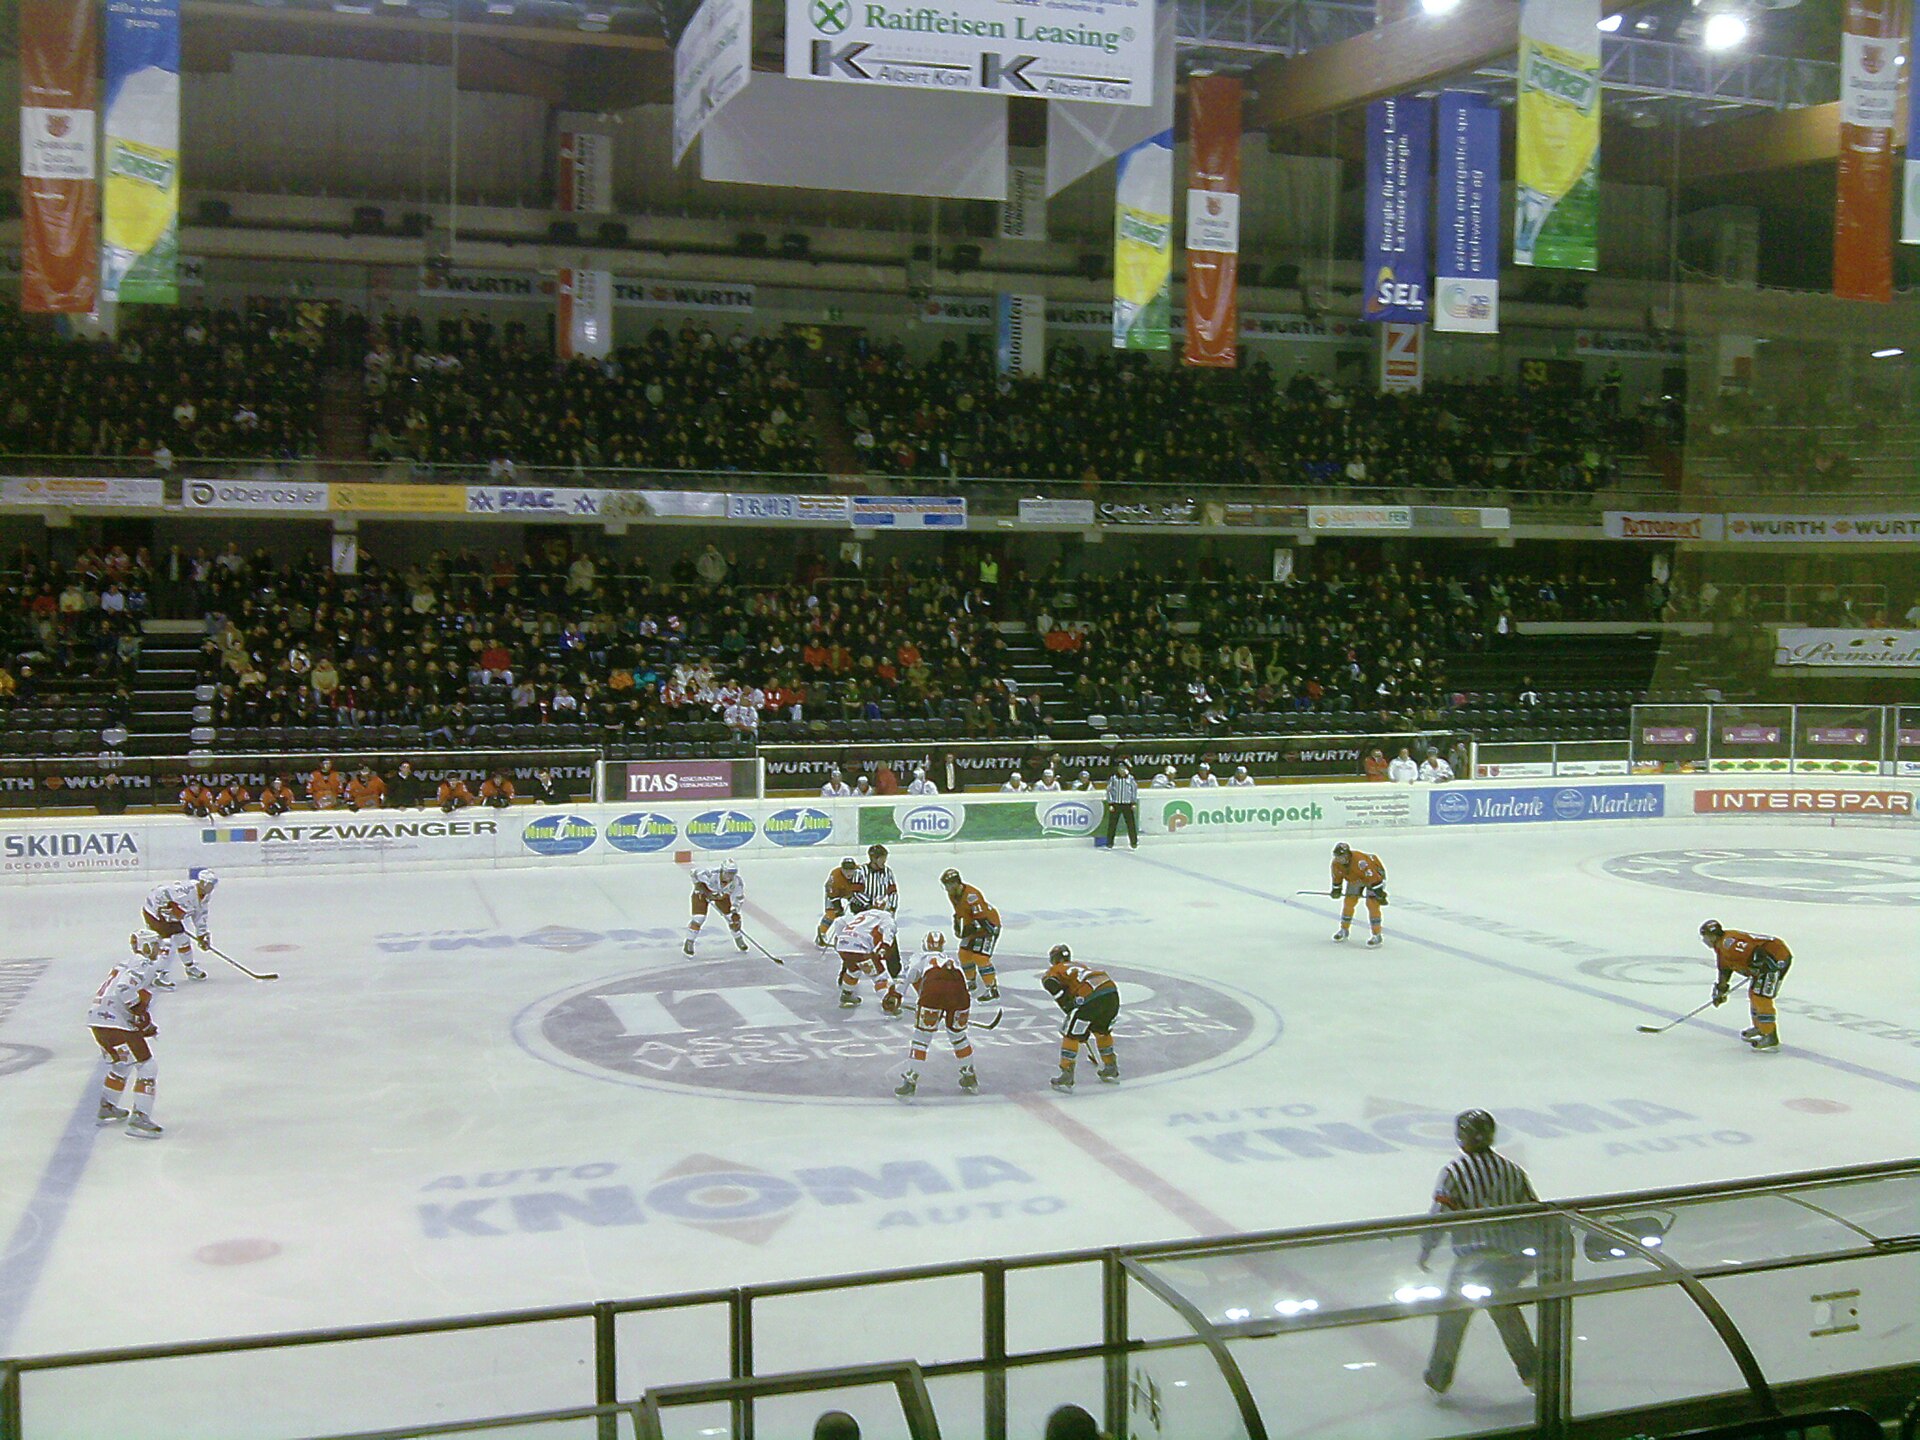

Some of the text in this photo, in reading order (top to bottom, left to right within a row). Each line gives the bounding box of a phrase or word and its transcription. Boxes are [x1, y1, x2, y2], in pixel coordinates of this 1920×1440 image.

[865, 4, 1006, 38] Raiffeisen
[878, 67, 930, 84] Albert
[1044, 78, 1094, 96] Albert
[1378, 284, 1424, 306] SEL
[629, 774, 678, 792] ITAS
[1473, 796, 1544, 819] Marlene
[1588, 792, 1658, 815] Marlene
[1712, 792, 1909, 811] INTERSPAR
[911, 814, 950, 831] mila
[1052, 810, 1089, 827] mila
[1197, 803, 1323, 826] naturapack
[260, 820, 497, 842] ATZWANGER
[4, 833, 138, 858] SKIDATA
[4, 857, 140, 870] access unlimited
[1166, 1102, 1319, 1128] AUTO
[1603, 1129, 1755, 1158] AUTO
[419, 1162, 623, 1192] AUTO
[416, 1154, 1038, 1239] KNOMA
[876, 1195, 1068, 1231] AUTO
